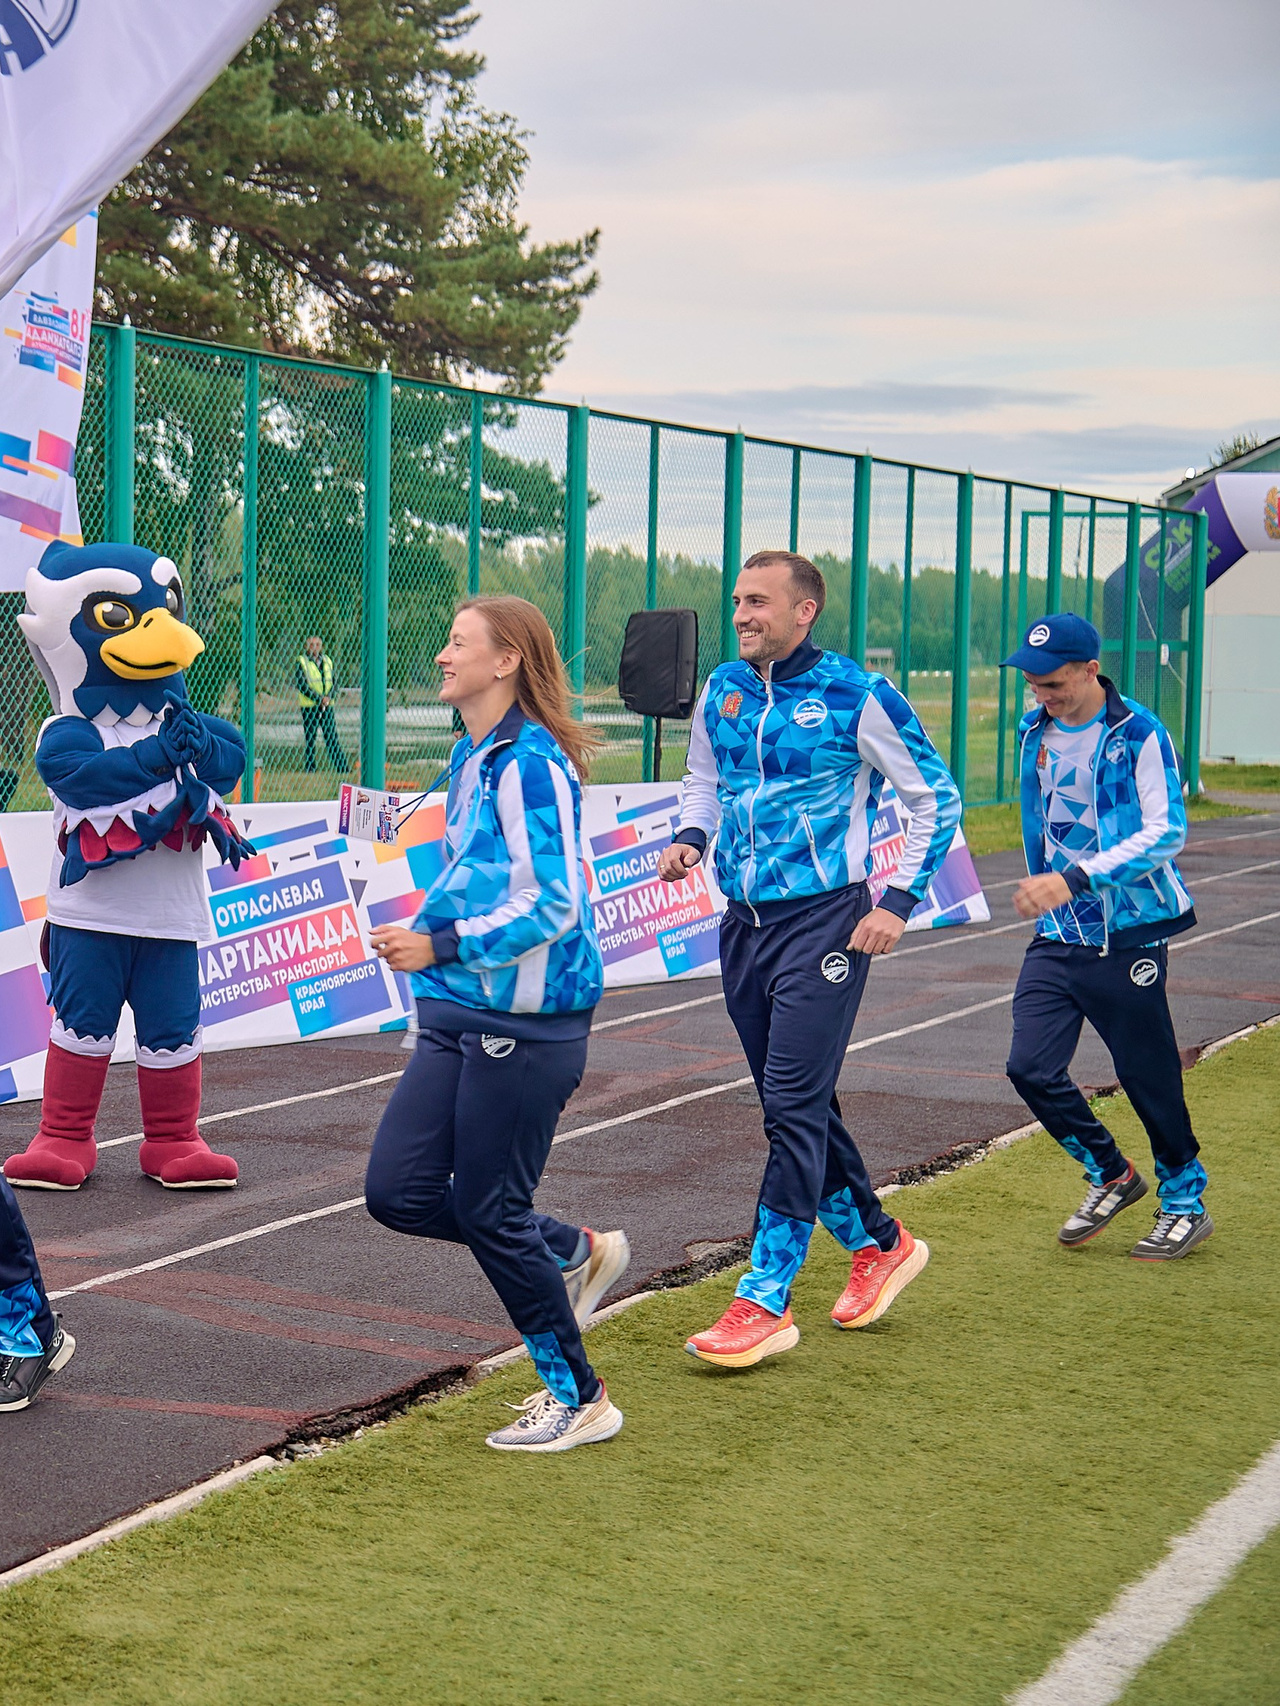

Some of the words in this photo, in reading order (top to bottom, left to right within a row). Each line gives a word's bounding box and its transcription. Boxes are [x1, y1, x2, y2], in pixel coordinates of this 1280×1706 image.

[341, 792, 350, 828] УЧАСТНИК
[215, 877, 325, 928] ОТРАСЛЕВАЯ
[643, 904, 702, 937] ТРАНСПОРТА
[661, 915, 722, 947] КРАСНОЯРСКОГО
[665, 942, 687, 959] КРАЯ
[271, 950, 349, 987] ТРАНСПОРТА
[294, 963, 377, 1000] КРАСНОЯРСКОГО
[299, 996, 326, 1015] КРАЯ
